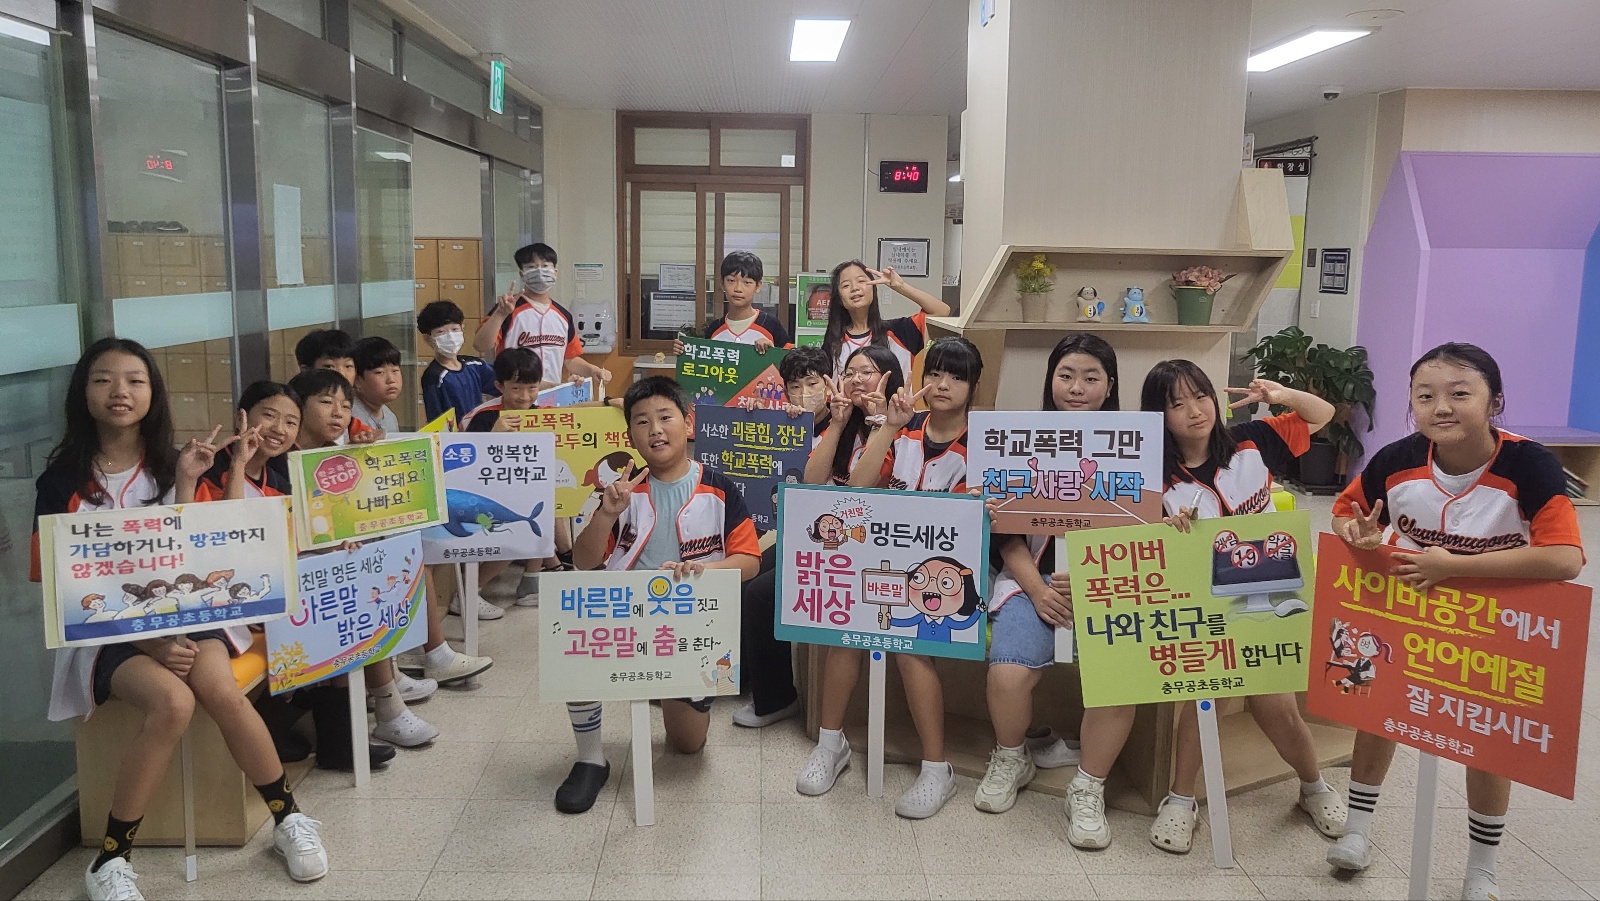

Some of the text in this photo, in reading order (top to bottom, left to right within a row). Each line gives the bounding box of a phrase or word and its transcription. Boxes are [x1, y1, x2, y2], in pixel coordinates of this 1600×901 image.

[894, 171, 919, 181] 8:40
[683, 343, 740, 365] 학교폭력
[682, 362, 739, 385] 로그아웃
[701, 421, 806, 447] 사소한 괴롭힘, 장난
[984, 428, 1144, 460] 학교폭력 그만
[365, 450, 427, 470] 학교폭력
[444, 446, 473, 463] 소통
[487, 444, 540, 464] 행복한
[701, 451, 783, 476] 또한 학교폭력에
[321, 469, 356, 488] STOP
[374, 469, 426, 491] 안돼요!
[478, 466, 548, 486] 우리학교
[1090, 471, 1144, 503] 시작
[357, 491, 411, 512] 나빠요!
[840, 506, 864, 519] 거친말
[71, 516, 182, 538] 나는 폭력에
[359, 513, 424, 531] 충무공초등학교
[1031, 518, 1092, 528] 충무공초등학교
[1398, 514, 1528, 553] Chungmugong
[70, 527, 265, 558] 가담하거나, 방관하지
[870, 522, 958, 551] 멍든세상
[443, 547, 501, 559] 충무공초등학교
[1080, 539, 1166, 575] 사이버
[1235, 549, 1256, 566] 19
[71, 553, 184, 579] 않겠습니다!
[298, 556, 385, 592] 친말 멍든 세상
[795, 551, 856, 589] 밝은
[561, 586, 644, 619] 바른말에
[867, 582, 904, 598] 바른말
[1085, 572, 1191, 609] 폭력은...
[132, 606, 243, 631] 충무공초등학교
[792, 588, 855, 625] 세상
[1333, 564, 1561, 650] 사이버공간에서
[338, 600, 412, 647] 밝은 세상
[1086, 607, 1227, 645] 나와 친구를
[564, 625, 721, 659] 고운말에 춤을 춘다~
[841, 632, 914, 650] 충무공초등학교
[1150, 638, 1303, 676] 병들게 합니다
[1403, 633, 1546, 704] 언어예절
[610, 671, 673, 682] 충무공초등학교
[1161, 677, 1245, 695] 충무공초등학교
[1407, 684, 1553, 753] 잘 지킵시다
[1383, 718, 1475, 757] 충무공초등학교
